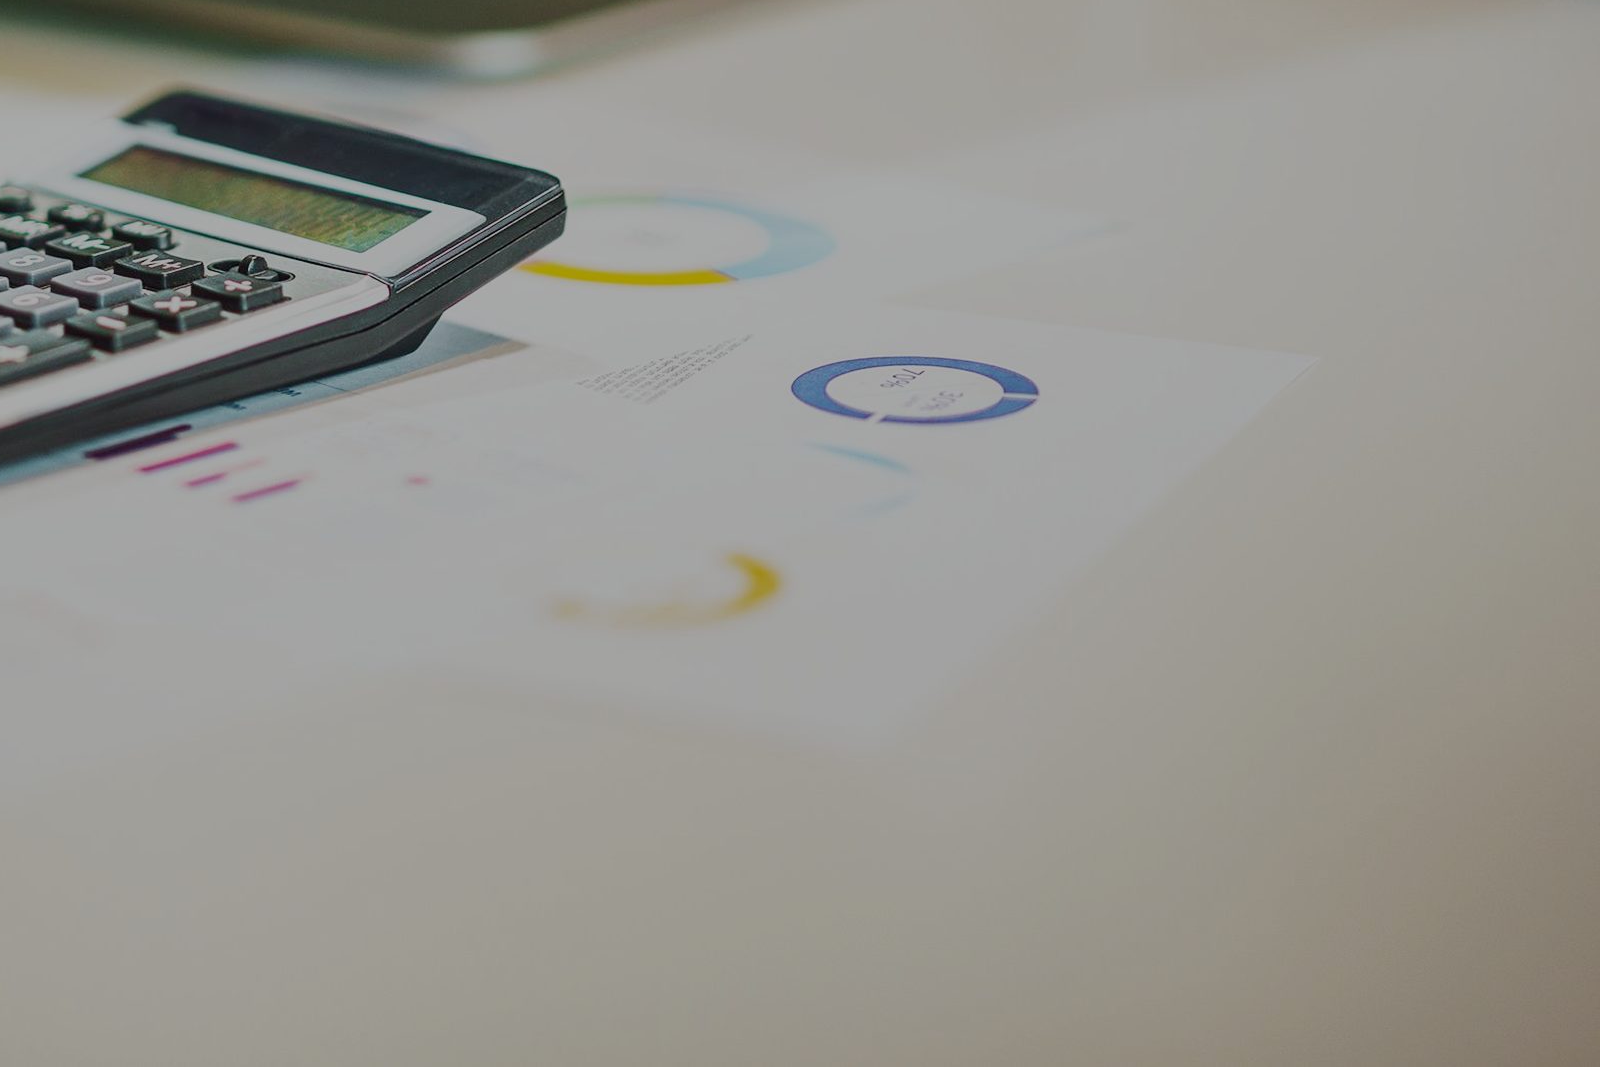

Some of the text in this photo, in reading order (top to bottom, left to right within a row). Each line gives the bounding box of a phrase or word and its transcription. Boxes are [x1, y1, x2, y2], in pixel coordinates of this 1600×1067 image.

[62, 235, 111, 250] M-
[8, 254, 45, 267] 8
[132, 253, 183, 270] M+
[74, 274, 113, 286] 9
[11, 292, 51, 306] 6
